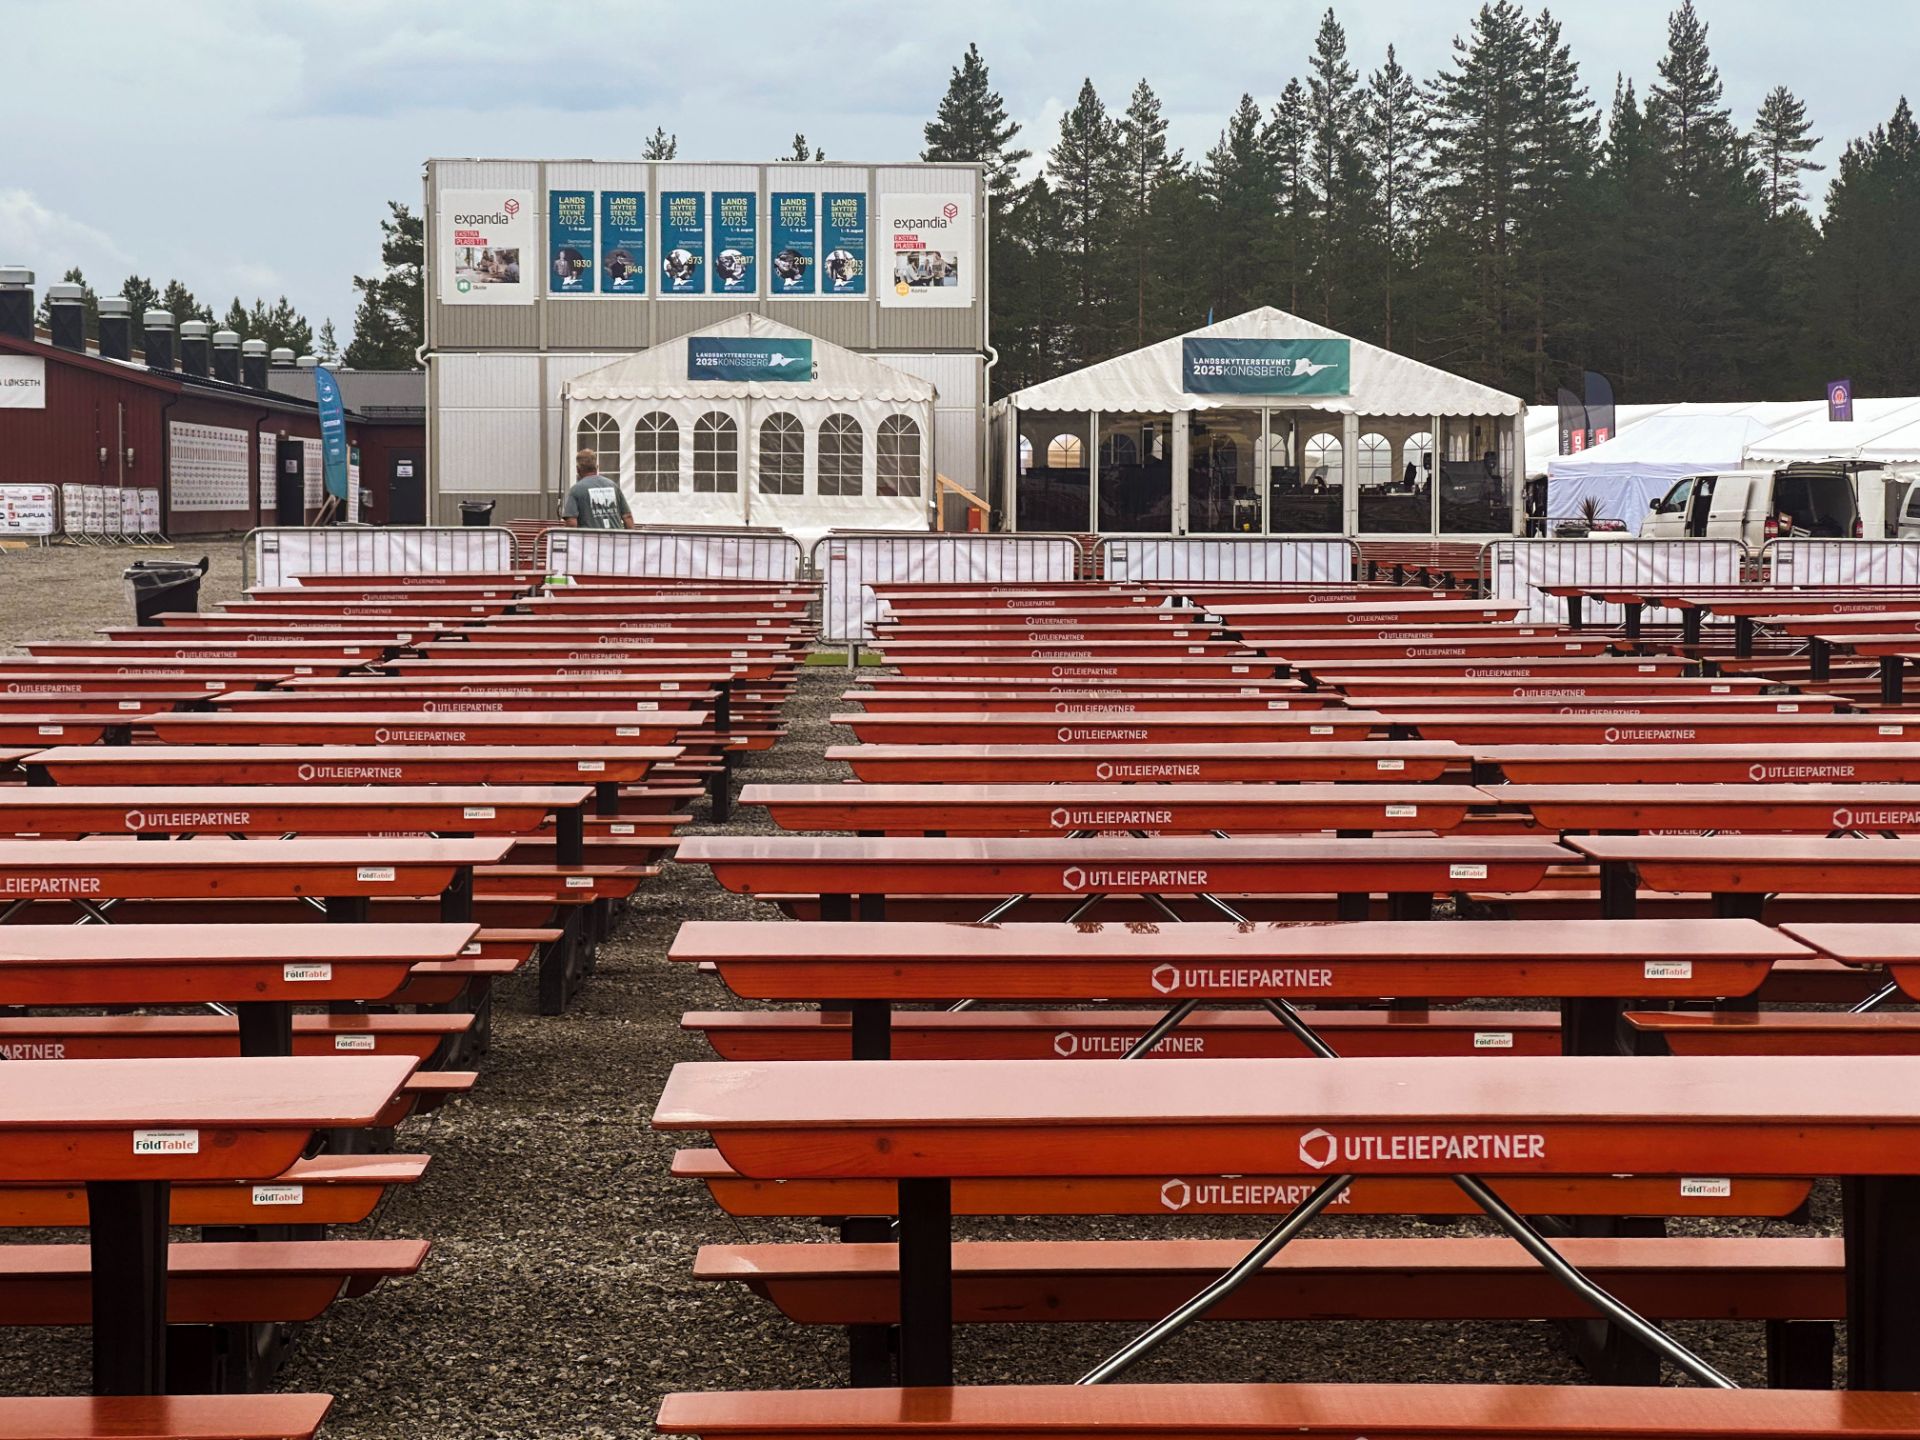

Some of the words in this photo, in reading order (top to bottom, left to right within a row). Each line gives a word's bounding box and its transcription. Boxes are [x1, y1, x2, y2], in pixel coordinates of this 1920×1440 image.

[455, 212, 508, 227] expandia
[559, 216, 585, 224] 2025
[610, 216, 636, 225] 2025
[670, 217, 696, 225] 2025
[721, 217, 747, 225] 2025
[780, 217, 806, 226] 2025
[831, 218, 857, 226] 2025
[894, 217, 947, 230] expandia
[4, 379, 40, 387] LØKSETH
[438, 703, 503, 712] UTLEIEPARTNER
[392, 731, 466, 741] UTLEIEPARTNER
[1074, 730, 1148, 739] UTLEIEPARTNER
[1622, 730, 1695, 739] UTLEIEPARTNER
[317, 767, 402, 778] UTLEIEPARTNER
[1116, 764, 1200, 776] UTLEIEPARTNER
[1768, 766, 1854, 778] UTLEIEPARTNER
[148, 812, 250, 826] UTLEIEPARTNER
[1073, 811, 1172, 824] UTLEIEPARTNER
[1090, 870, 1207, 885] UTLEIEPARTNER
[1185, 968, 1332, 988] UTLEIEPARTNER
[1082, 1037, 1204, 1052] UTLEIERTNER
[1345, 1135, 1545, 1160] UTLEIEPARTNER
[1196, 1185, 1350, 1204] UTLEIEPARTR
